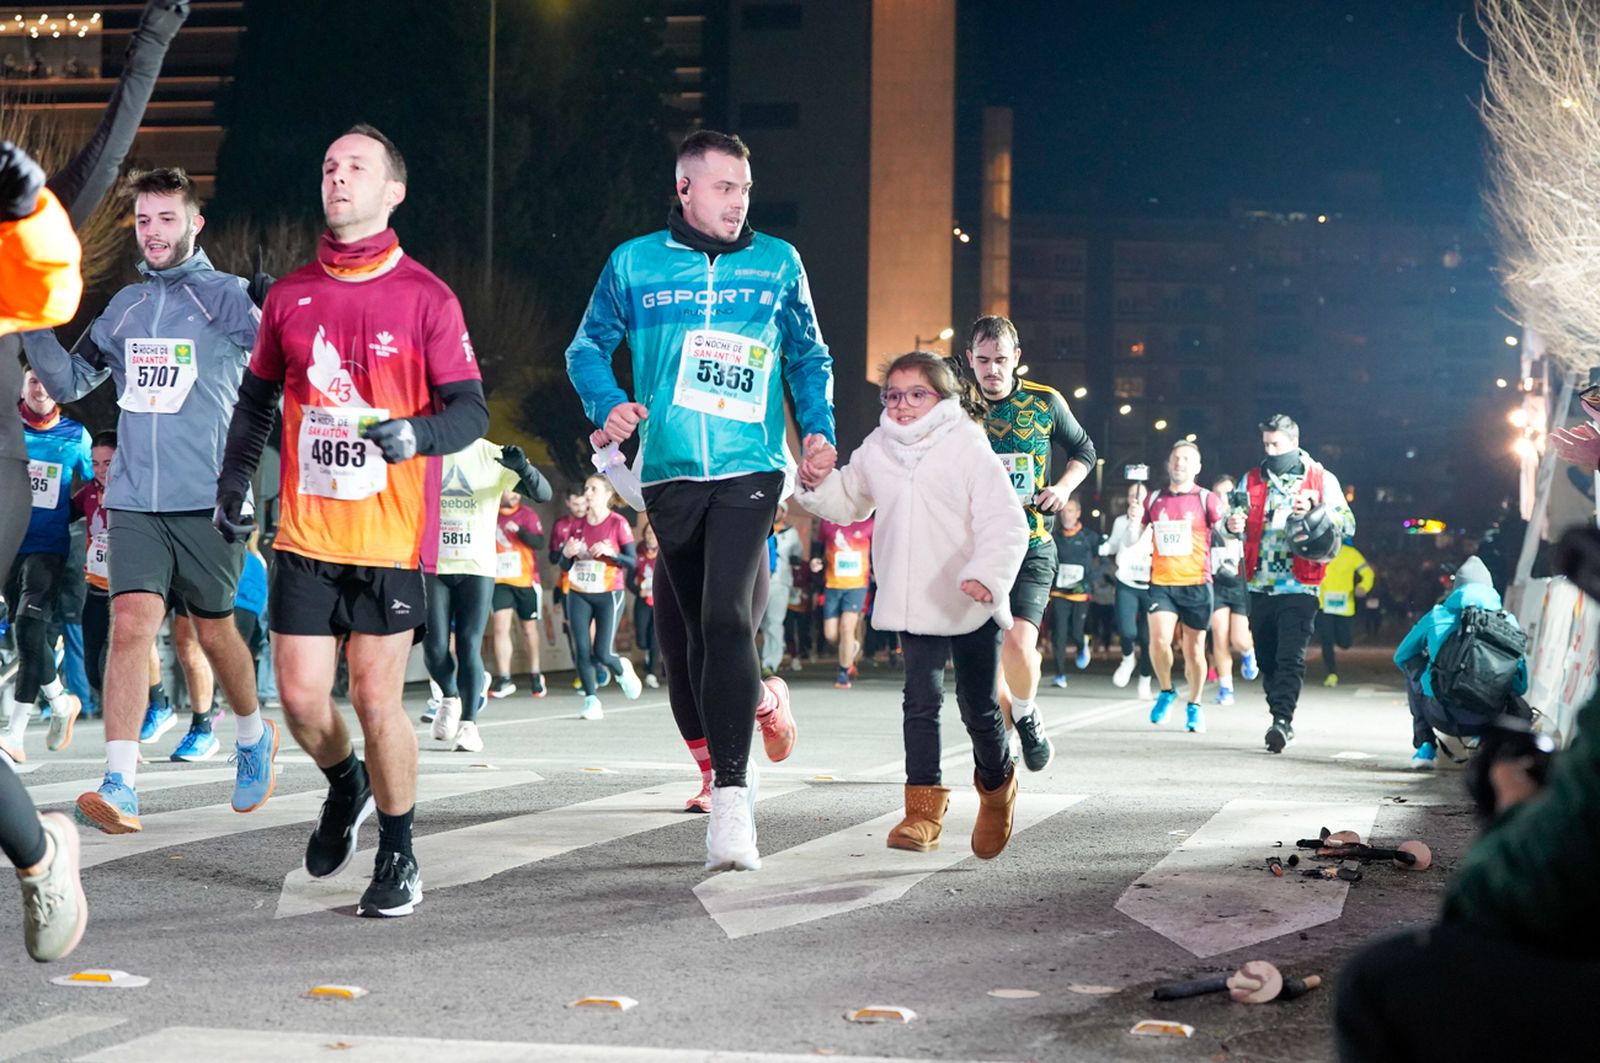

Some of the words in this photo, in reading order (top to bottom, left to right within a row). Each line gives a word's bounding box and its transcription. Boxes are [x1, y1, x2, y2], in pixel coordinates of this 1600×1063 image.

[642, 288, 755, 308] GSPORT
[693, 349, 711, 358] SAN
[704, 340, 731, 352] NOCHE
[732, 345, 743, 353] DE
[132, 355, 144, 364] SAN
[138, 365, 180, 387] 5707
[696, 359, 755, 393] 5353
[327, 377, 352, 402] 43
[337, 418, 350, 427] DE
[311, 438, 366, 468] 4863
[29, 477, 49, 492] 35
[440, 497, 477, 509] eebok
[442, 532, 472, 545] 5814
[95, 549, 107, 563] 5
